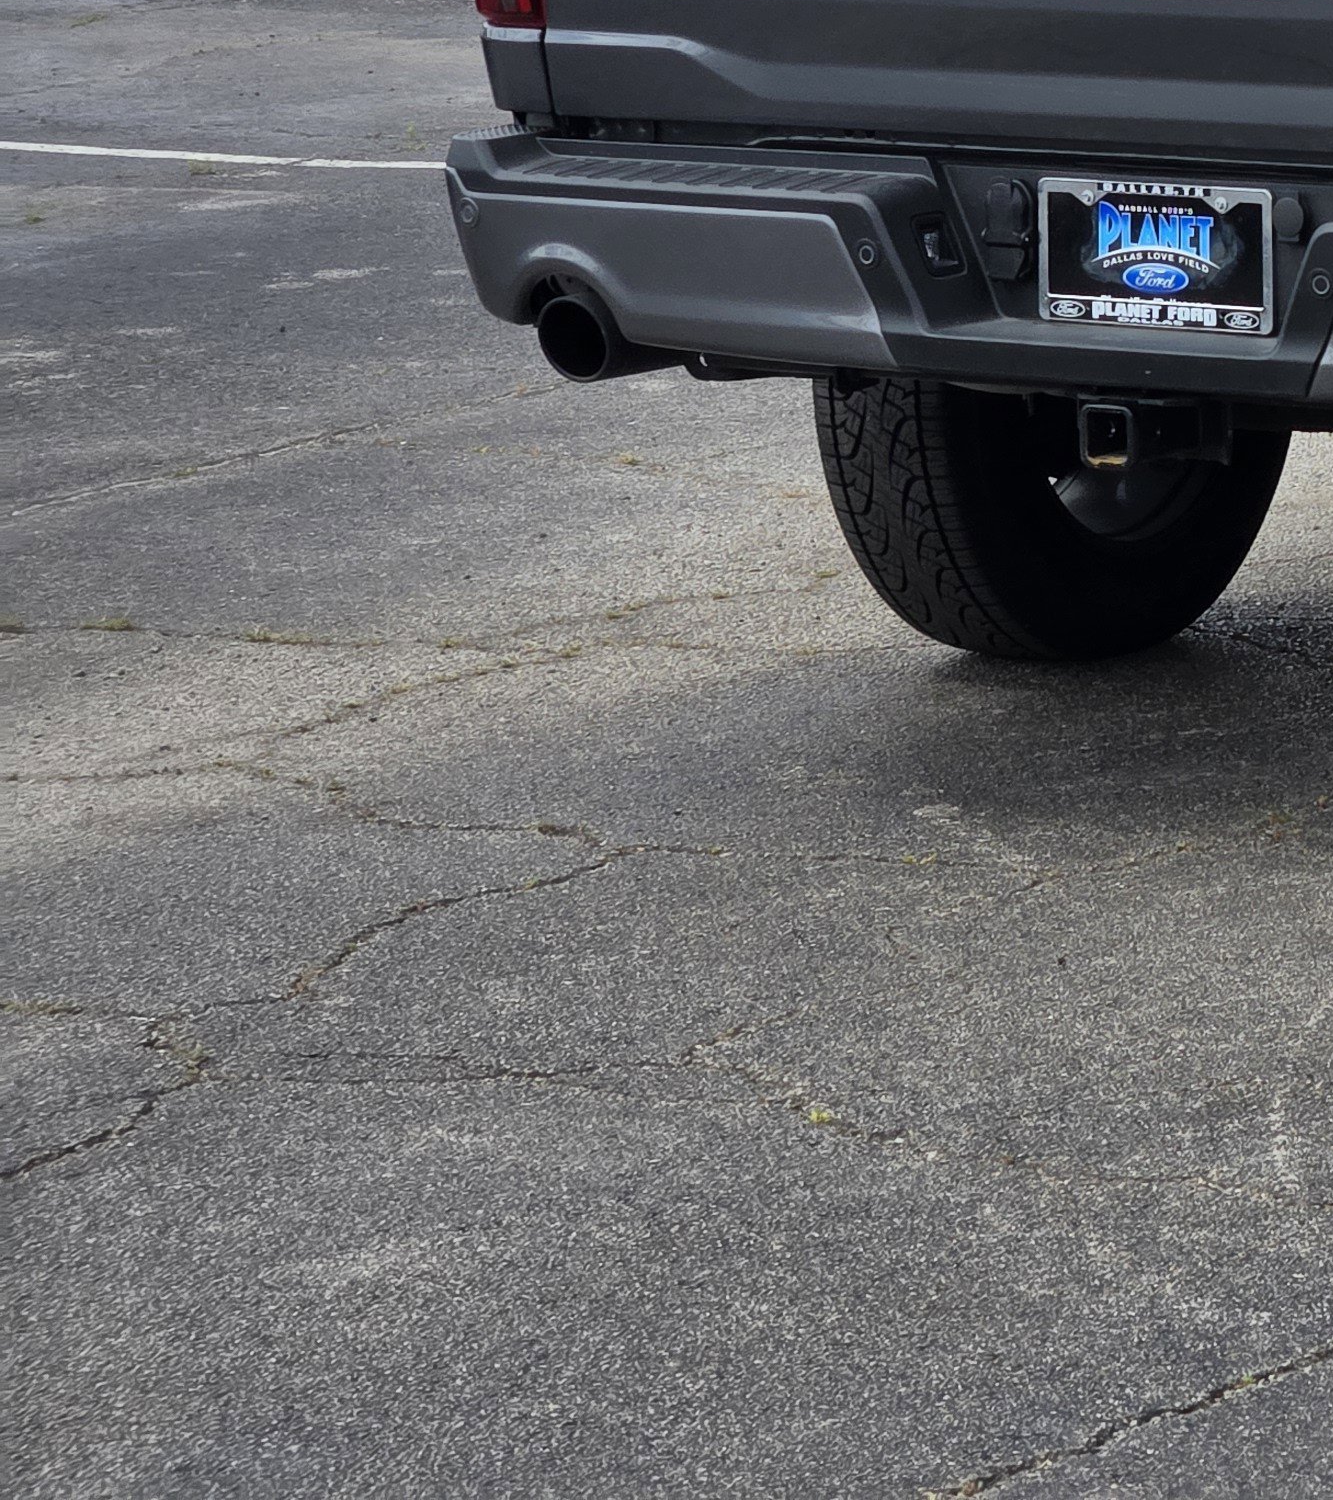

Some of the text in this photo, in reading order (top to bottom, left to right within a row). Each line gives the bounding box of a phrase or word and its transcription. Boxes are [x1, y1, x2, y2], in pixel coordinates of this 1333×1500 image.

[1099, 201, 1214, 262] PLANET
[1103, 252, 1210, 274] DALLAS LOVE FIELD
[1135, 268, 1176, 289] Ford
[1092, 301, 1162, 319] PLANET
[1167, 306, 1217, 327] FORD
